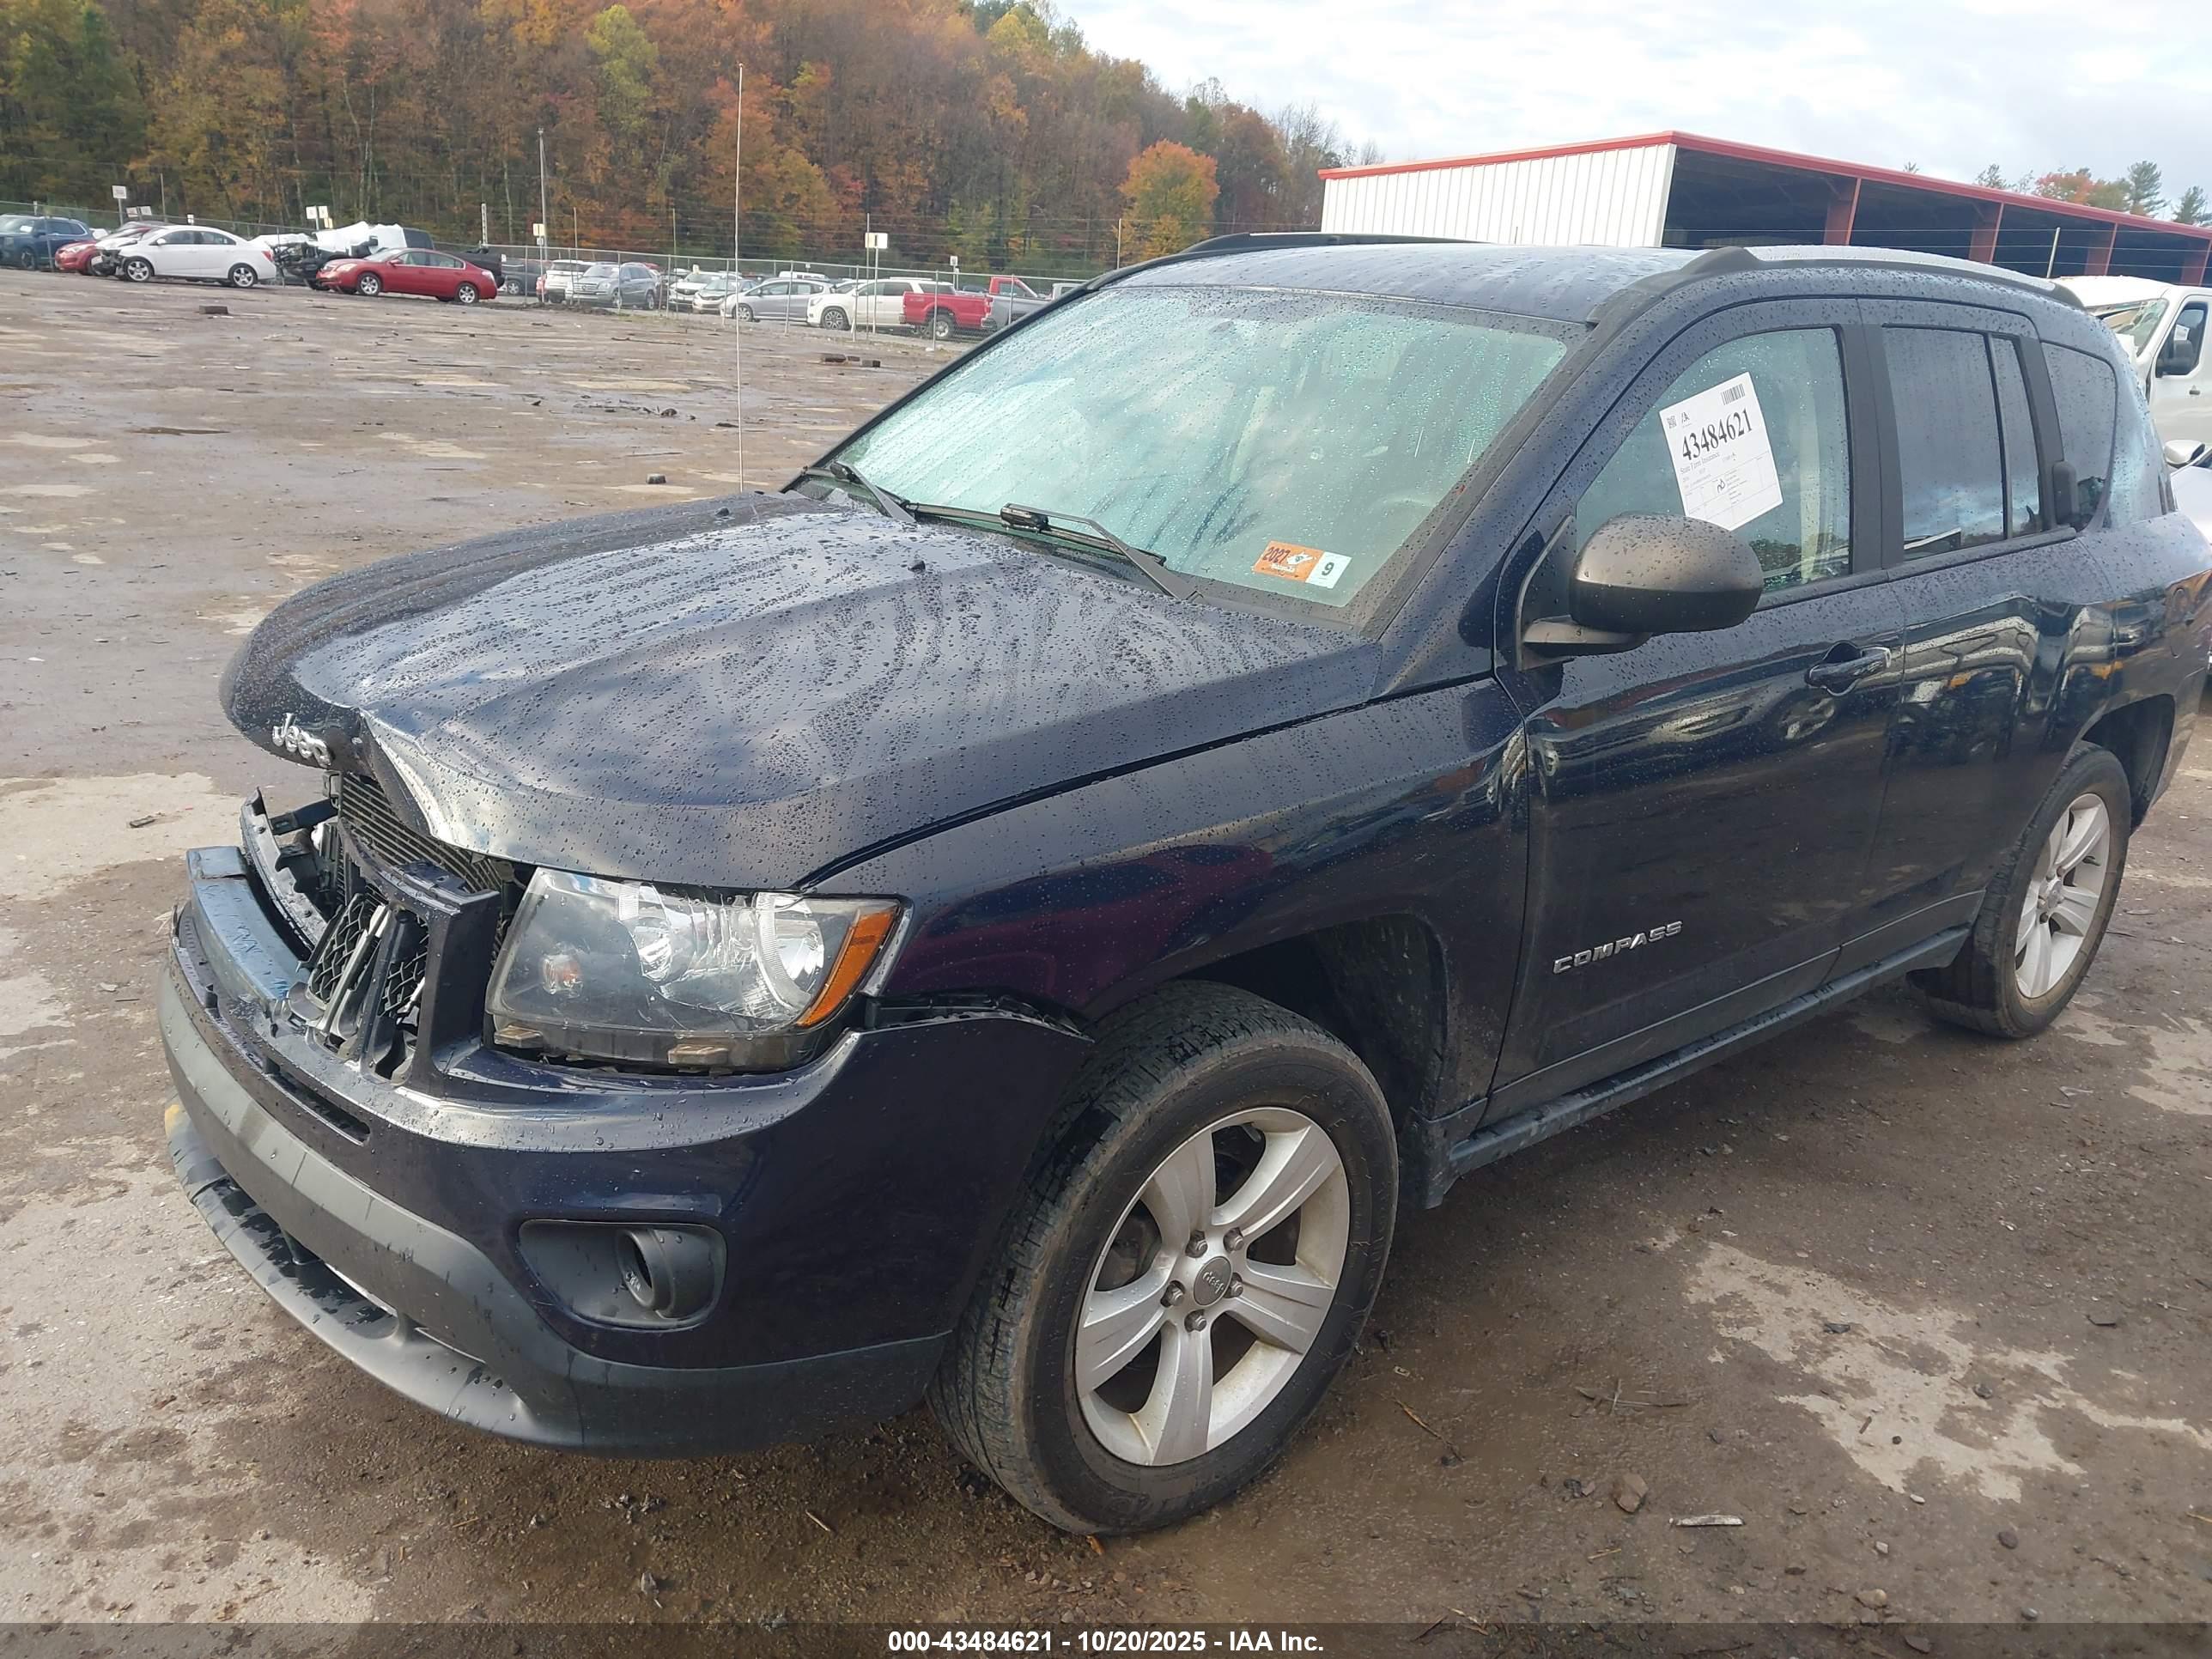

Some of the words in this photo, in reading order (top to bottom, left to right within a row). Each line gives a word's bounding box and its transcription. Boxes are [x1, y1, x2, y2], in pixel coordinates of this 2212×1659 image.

[1681, 408, 1753, 461] 43484621
[1322, 562, 1334, 576] 9
[271, 712, 331, 769] Jeep
[1553, 921, 1683, 974] COMPASS
